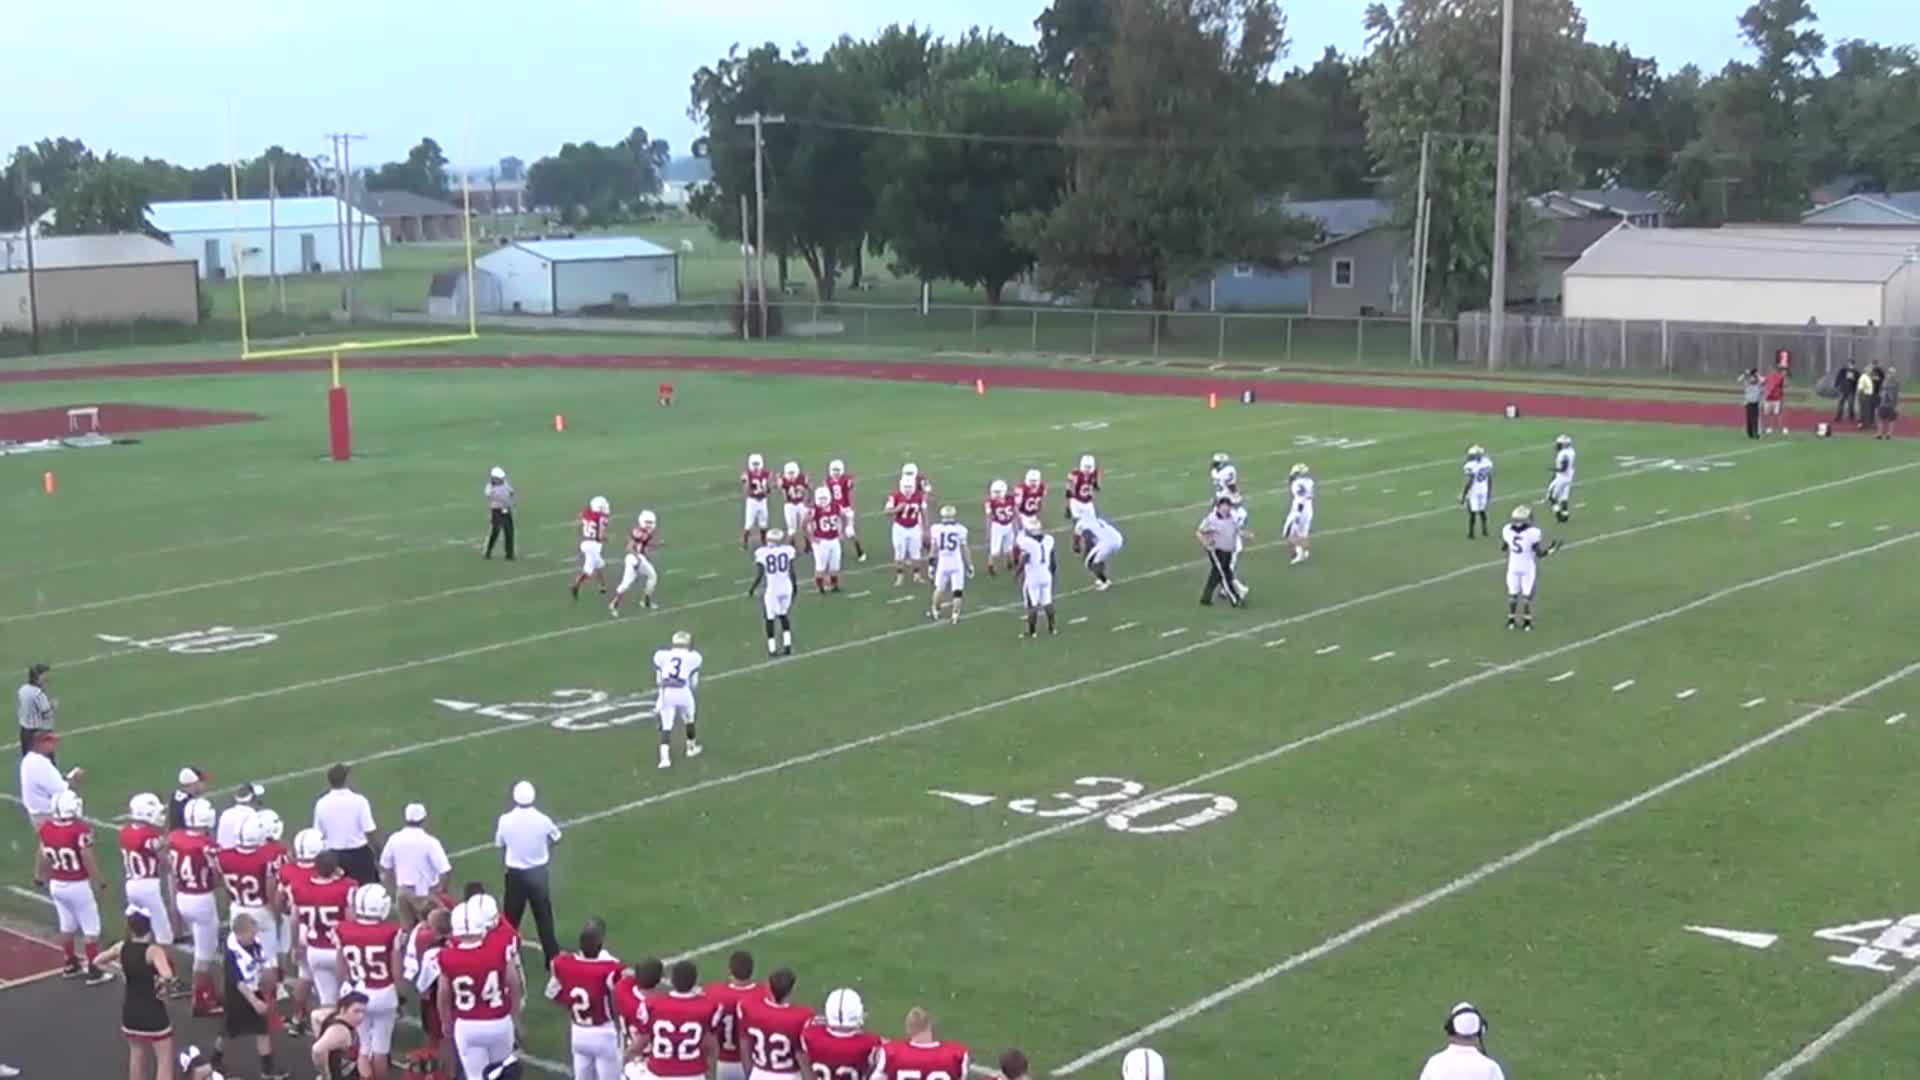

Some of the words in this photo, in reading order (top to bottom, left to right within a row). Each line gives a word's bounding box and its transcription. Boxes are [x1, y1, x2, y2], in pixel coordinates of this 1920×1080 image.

[940, 532, 958, 551] 15
[1039, 544, 1045, 563] 1
[1512, 536, 1523, 554] 5
[765, 552, 789, 574] 80
[669, 657, 682, 679] 3
[1008, 777, 1238, 833] 30
[224, 873, 263, 906] 52
[343, 945, 389, 980] 85
[452, 970, 503, 1011] 64
[570, 987, 592, 1025] 2
[653, 1019, 702, 1060] 62
[748, 1027, 793, 1069] 32
